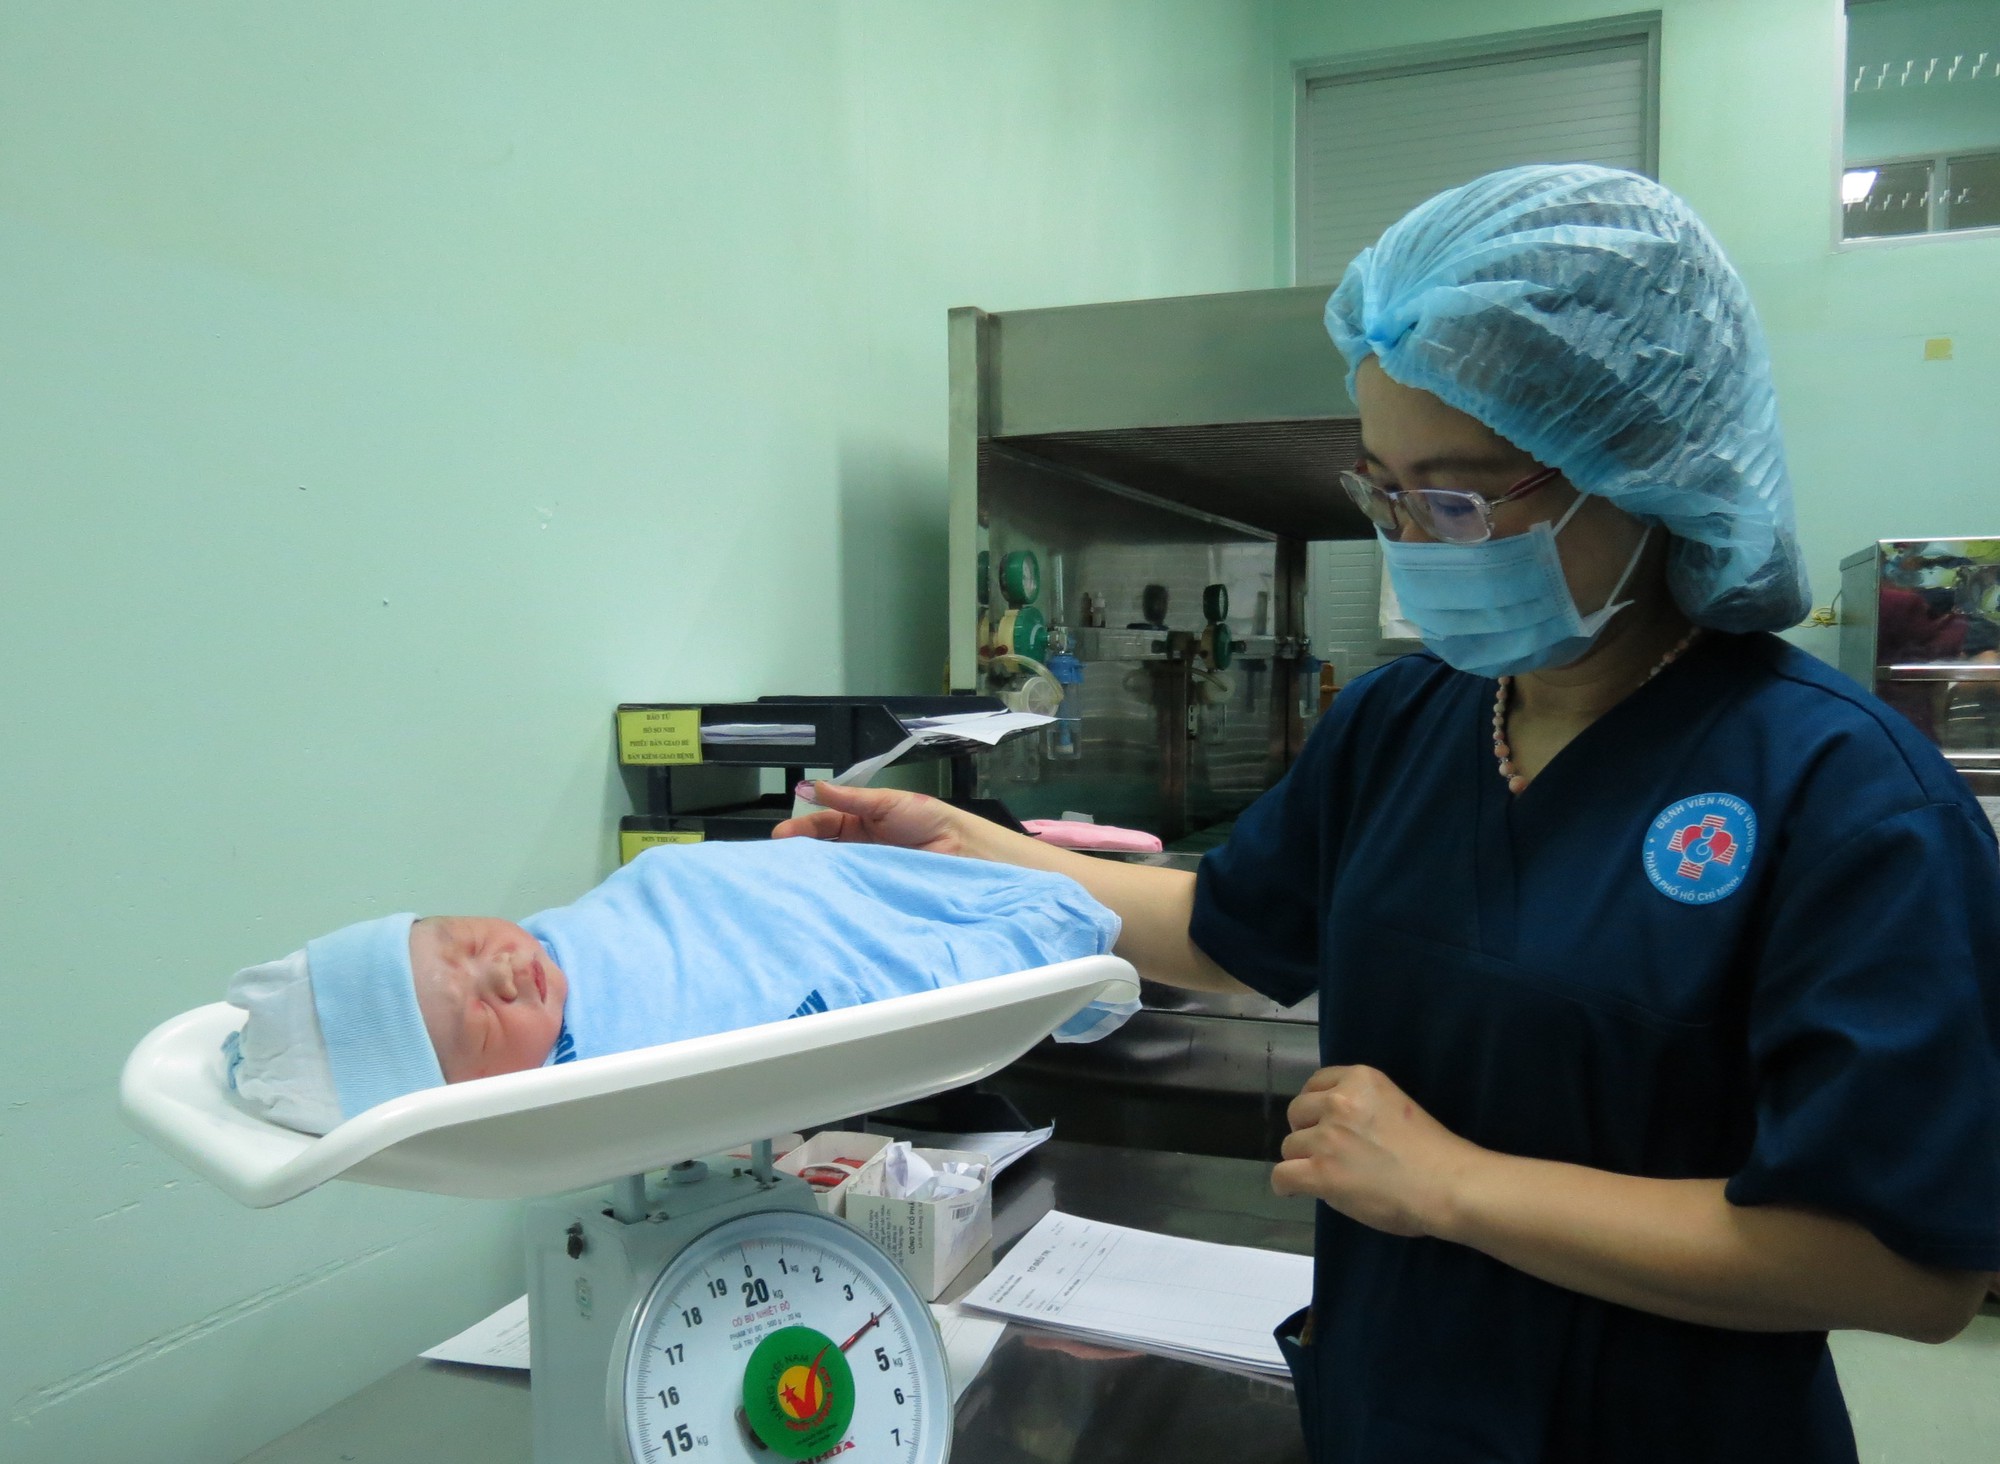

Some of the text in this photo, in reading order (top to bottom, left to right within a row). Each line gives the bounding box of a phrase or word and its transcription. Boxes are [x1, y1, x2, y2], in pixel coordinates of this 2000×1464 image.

[1655, 804, 1685, 830] BỆNH
[1686, 795, 1715, 809] VIỆN
[1660, 880, 1681, 896] PHỐ
[1716, 875, 1740, 896] MINH
[744, 1264, 753, 1278] 0
[778, 1258, 799, 1274] 1 kg
[812, 1266, 823, 1283] 2
[707, 1278, 728, 1298] 19
[741, 1278, 784, 1308] 20 kg
[843, 1284, 854, 1301] 3
[682, 1307, 703, 1328] 18
[665, 1344, 684, 1366] 17
[874, 1347, 903, 1372] 5 kg
[658, 1386, 680, 1409] 16
[894, 1388, 905, 1406] 6
[662, 1423, 709, 1457] 15 kg
[890, 1428, 900, 1447] 7
